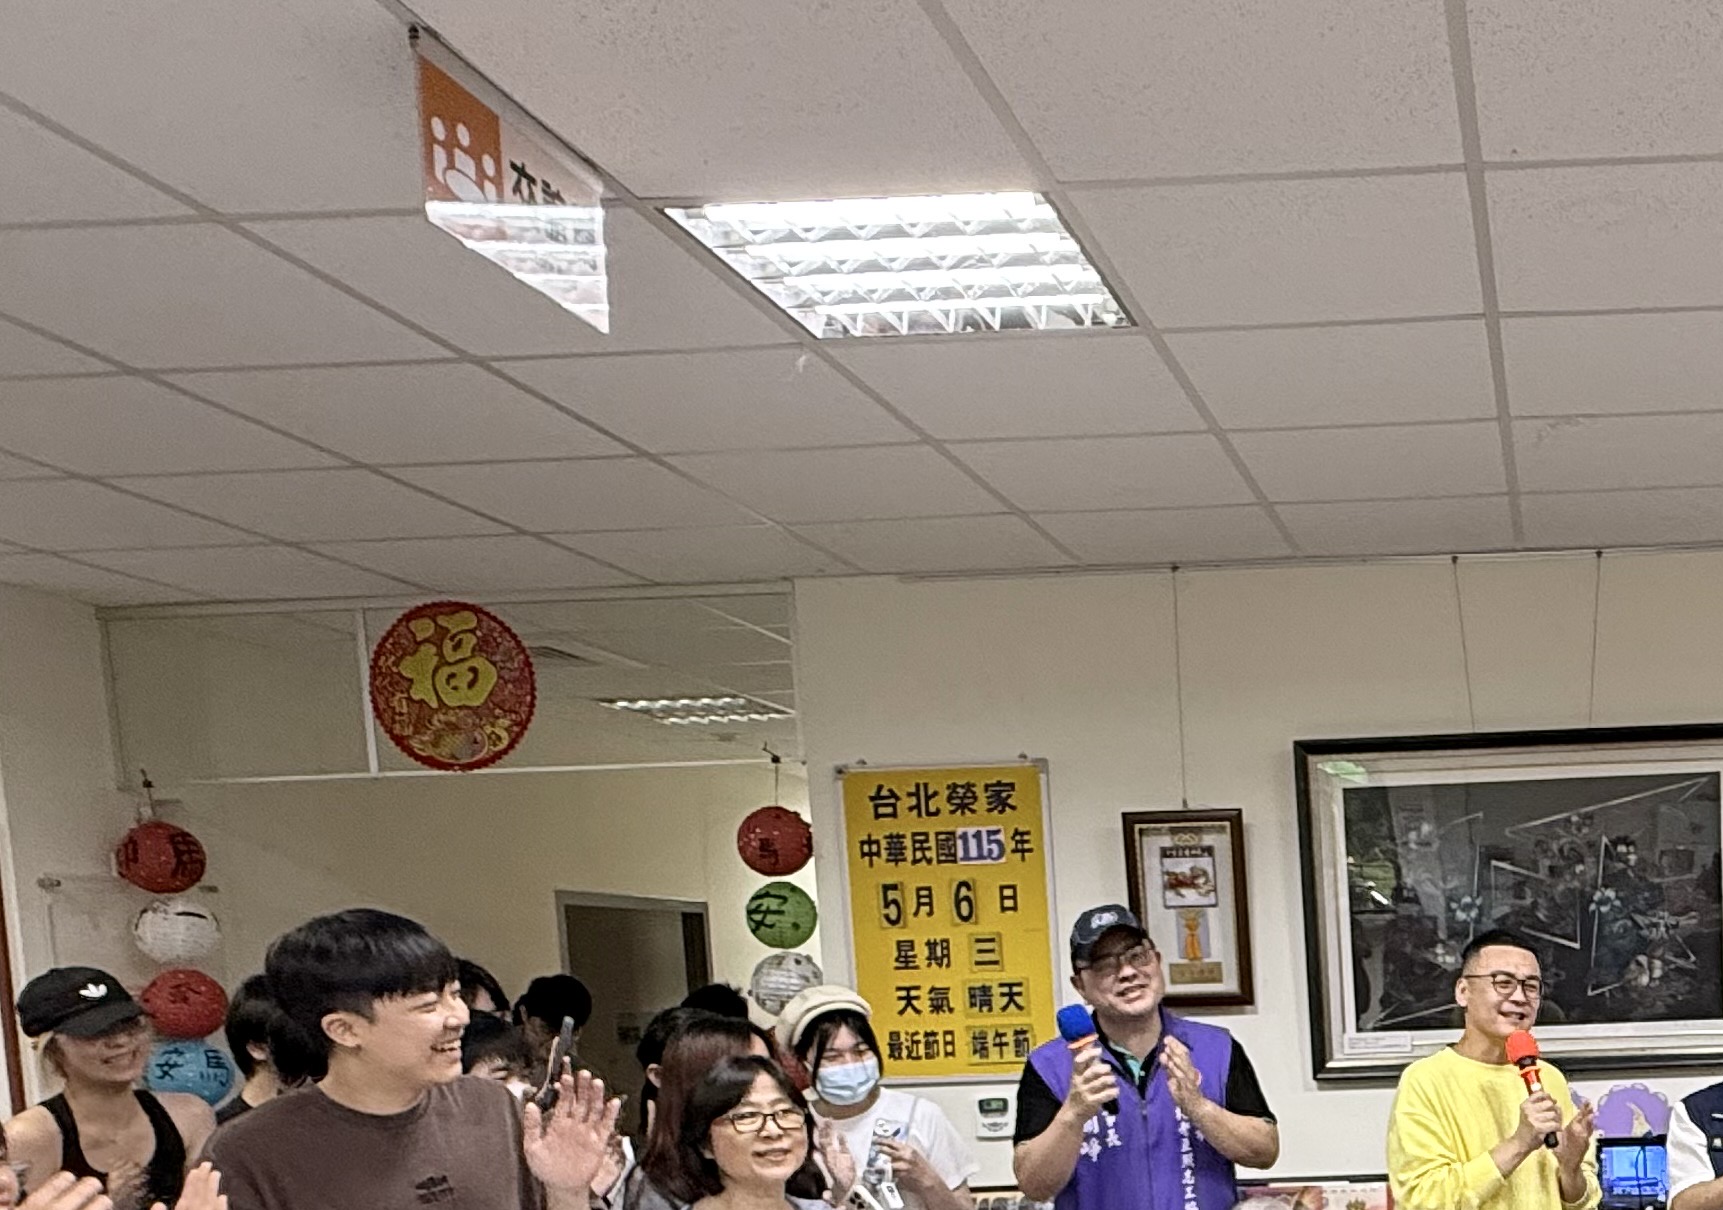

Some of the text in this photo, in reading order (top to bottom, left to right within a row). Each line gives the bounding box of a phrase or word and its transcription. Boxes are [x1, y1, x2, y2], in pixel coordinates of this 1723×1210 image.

[868, 780, 1018, 820] 台北榮家
[858, 827, 1035, 868] 中華民國115年
[881, 880, 1019, 927] 5月6日
[893, 937, 1000, 970] 星期三
[895, 980, 1026, 1016] 天氣 晴天
[887, 1030, 956, 1062] 最近節日
